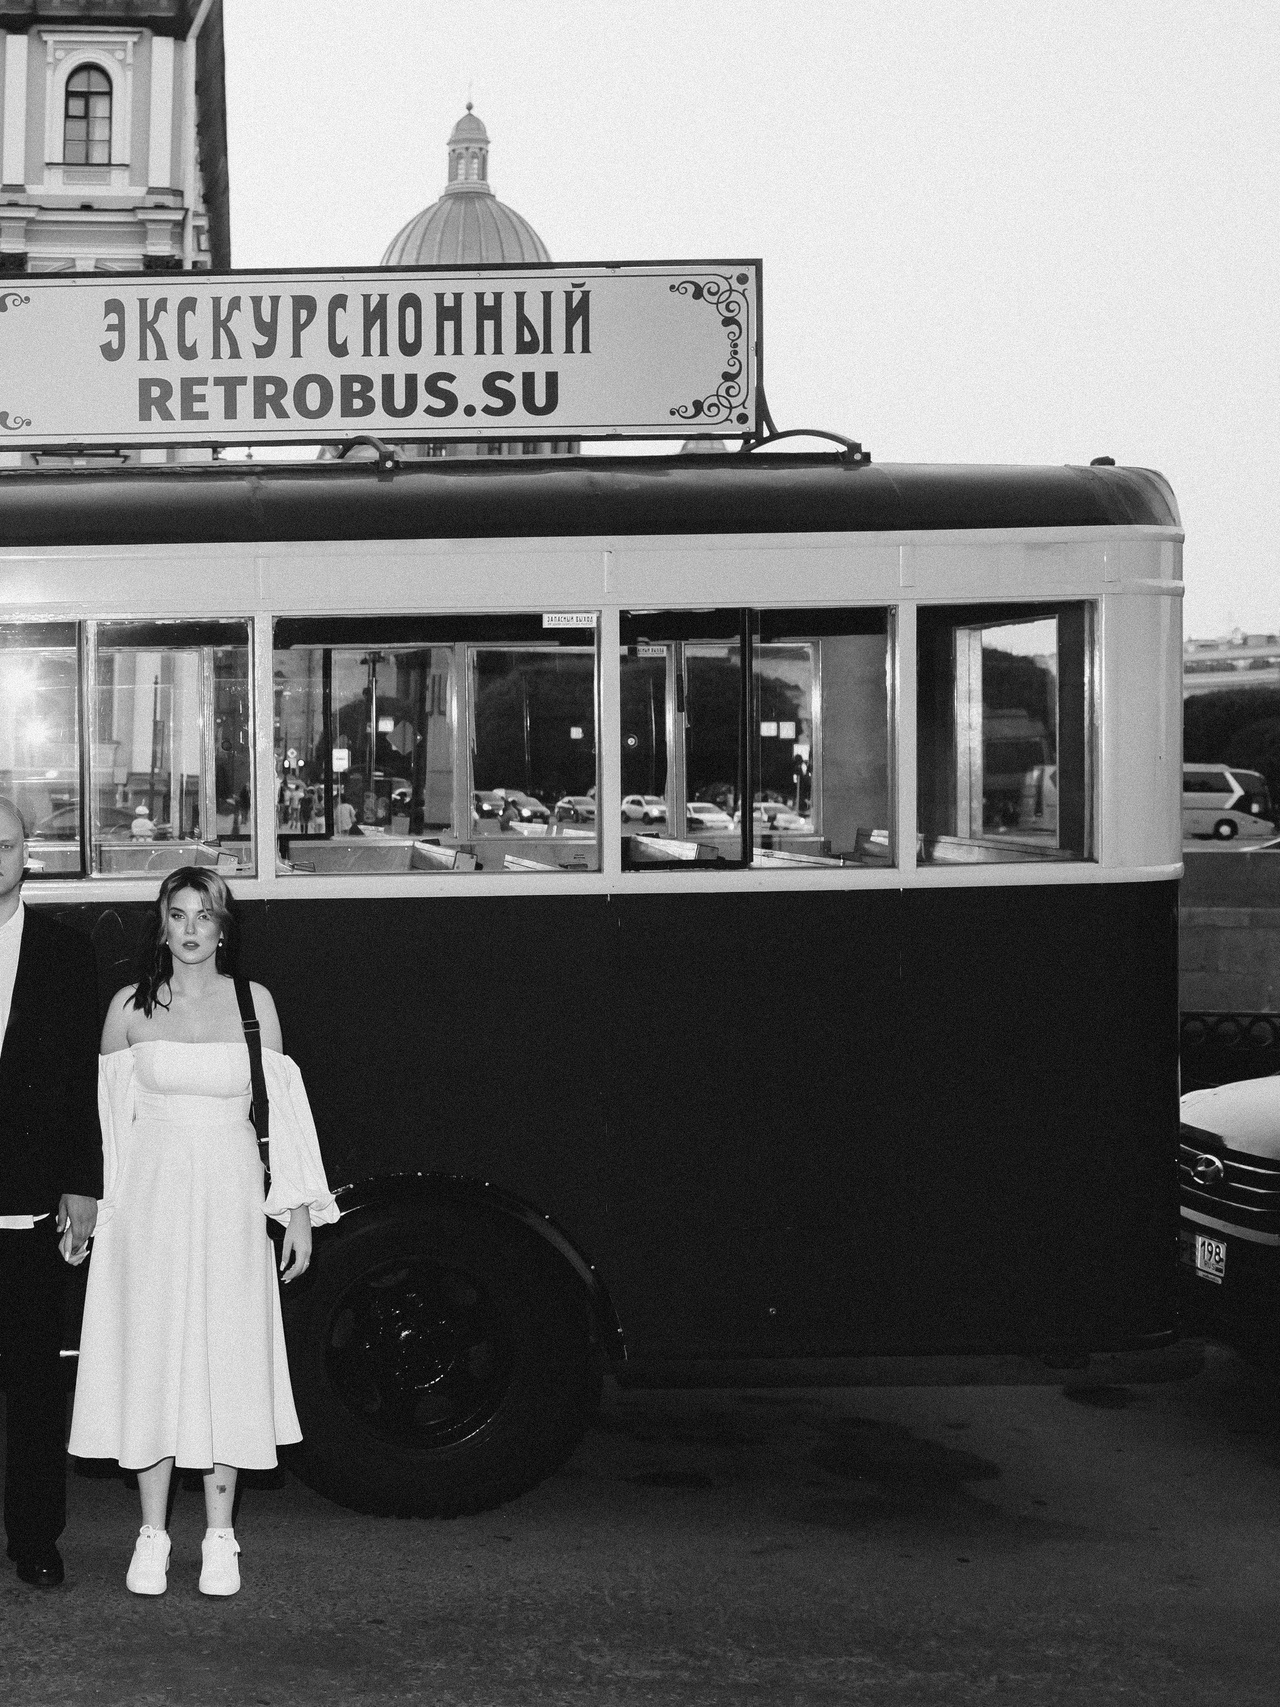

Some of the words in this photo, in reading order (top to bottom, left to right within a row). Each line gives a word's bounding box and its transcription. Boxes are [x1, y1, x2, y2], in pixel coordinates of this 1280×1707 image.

[99, 281, 592, 362] ЭКСКУРСИОННЫЙ
[138, 371, 559, 421] RETROBUS.SU
[575, 615, 594, 623] ВЫХОД
[1200, 1240, 1222, 1264] 198
